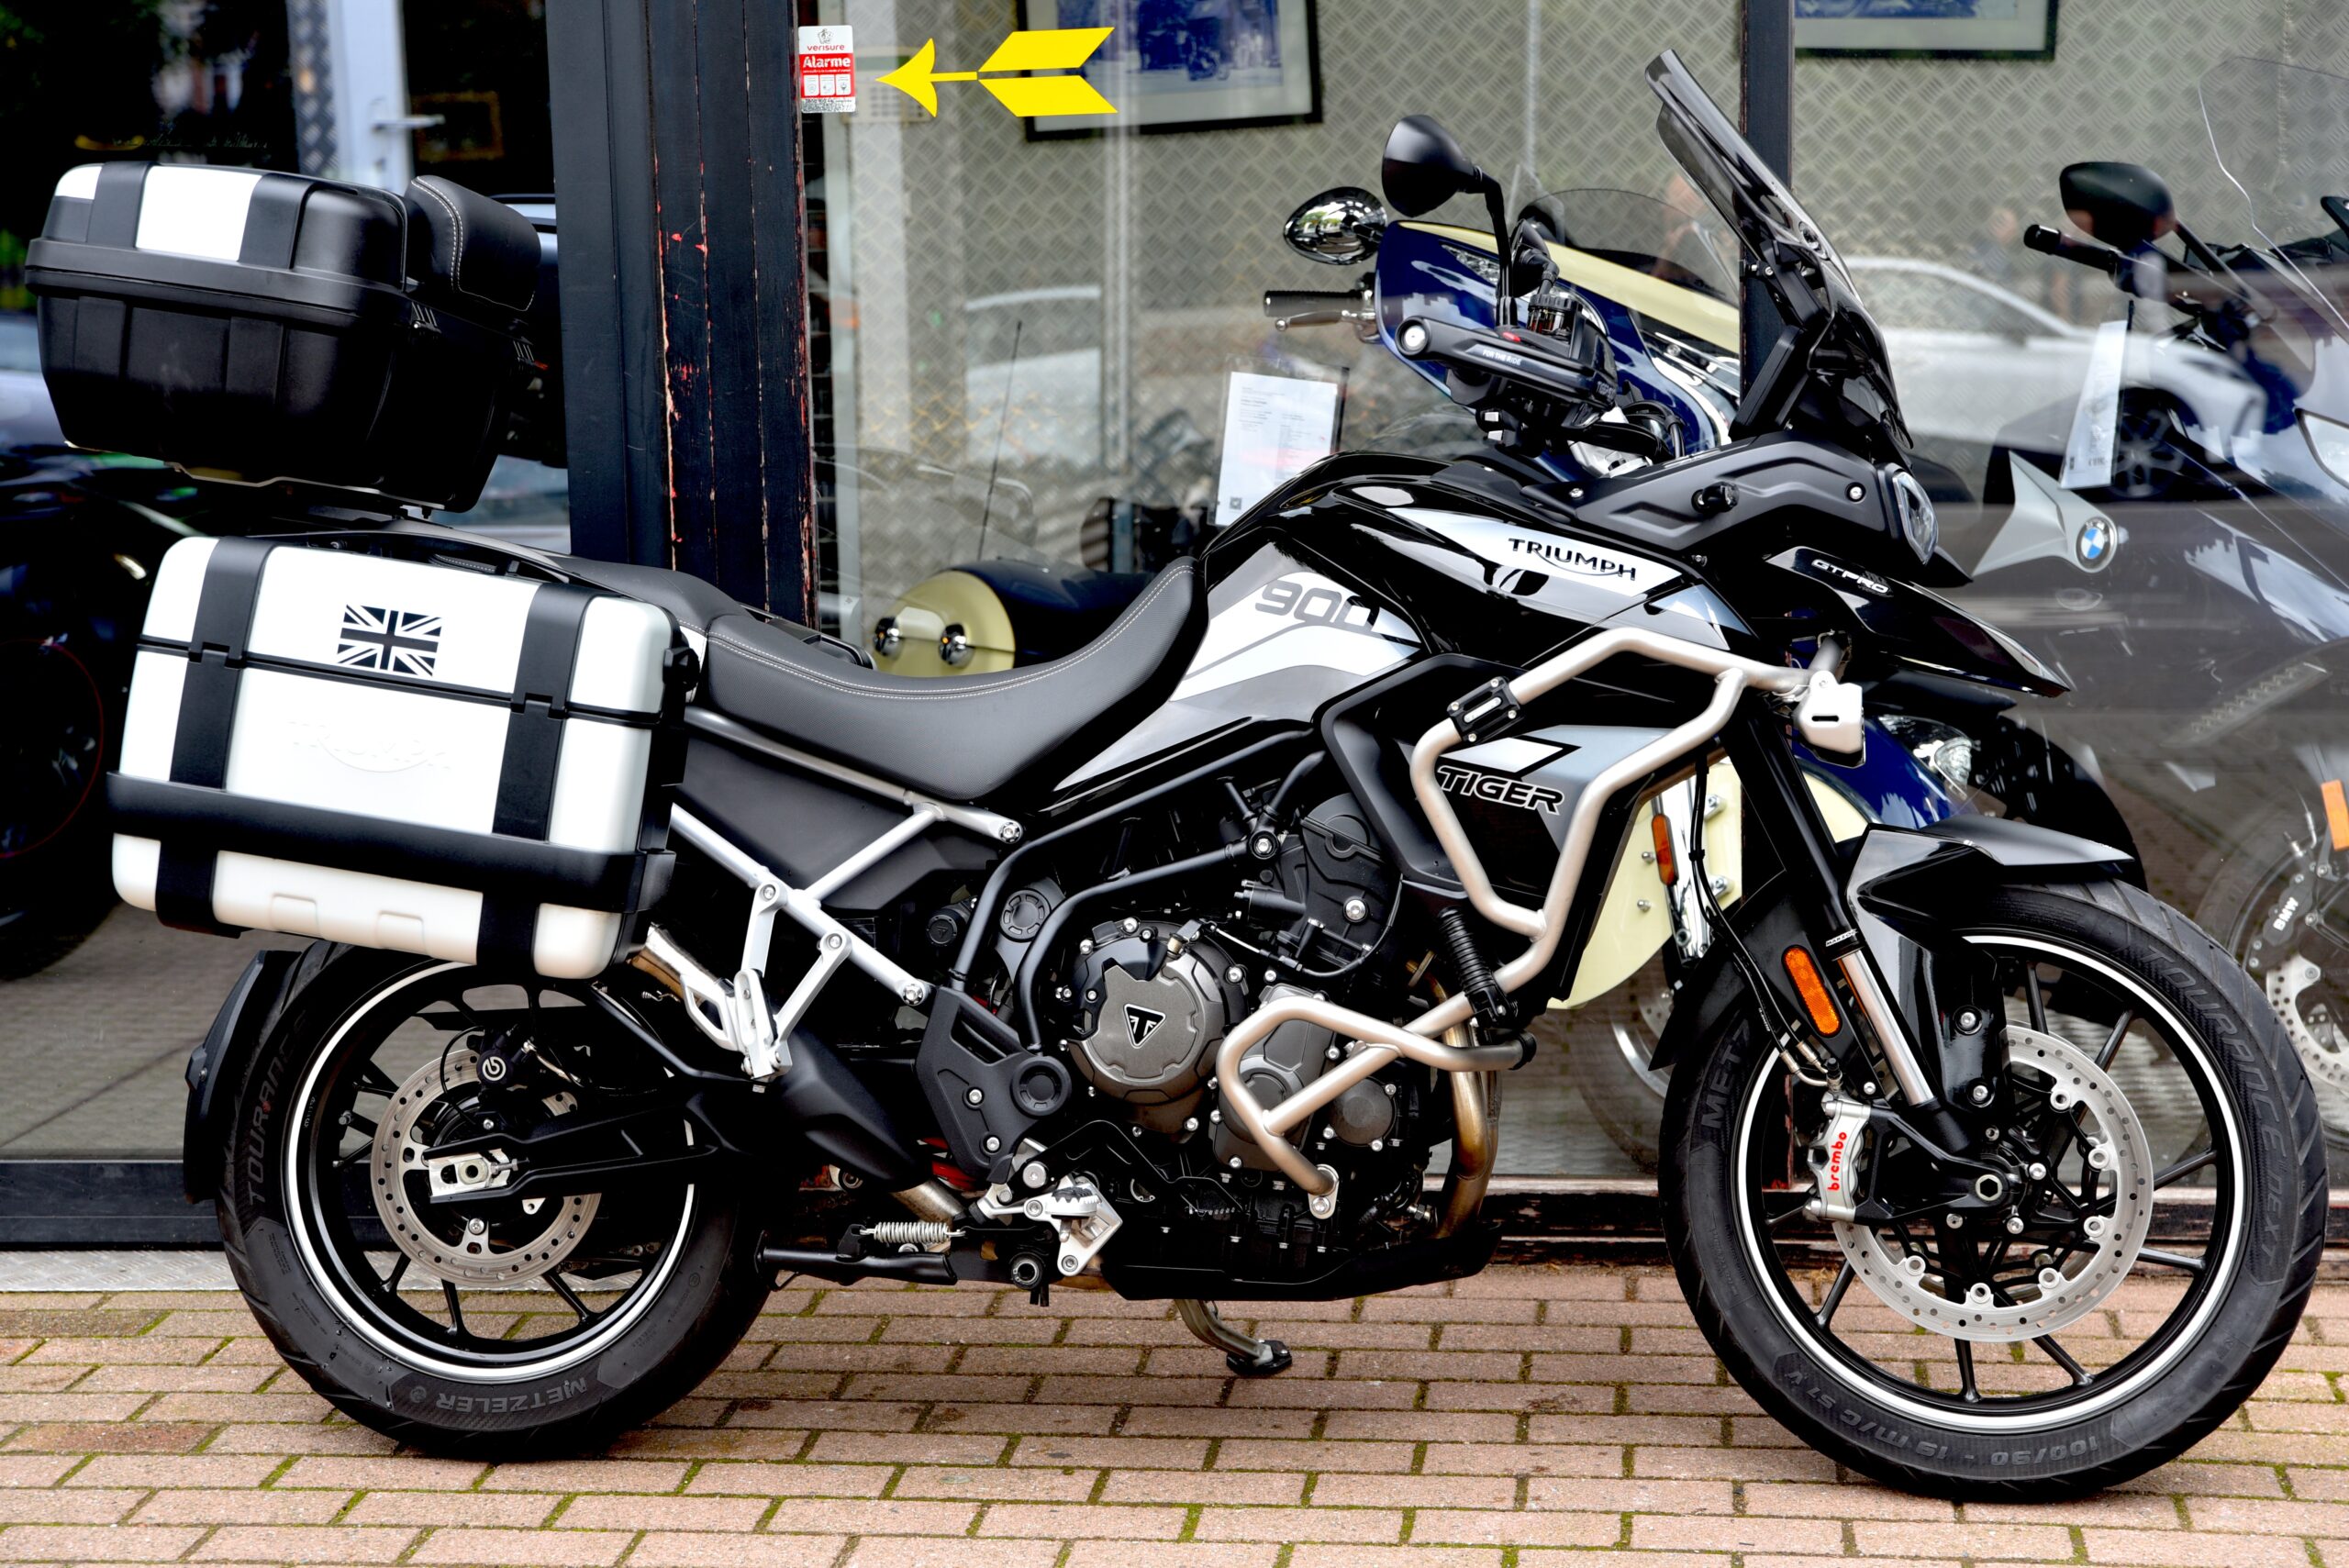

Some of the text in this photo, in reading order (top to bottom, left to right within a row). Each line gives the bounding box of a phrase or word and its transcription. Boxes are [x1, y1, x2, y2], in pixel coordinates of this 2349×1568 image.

[803, 55, 851, 68] Alarme
[1508, 538, 1636, 582] TRIUMPH
[1254, 579, 1380, 631] 900
[1437, 764, 1565, 816] TIGER
[2273, 896, 2299, 931] BMW
[2140, 946, 2287, 1158] TOURANCE
[1827, 1131, 1847, 1191] brembo
[436, 1376, 588, 1414] METZELER
[1915, 1440, 1949, 1461] 19
[1989, 1435, 2099, 1467] 100/90
